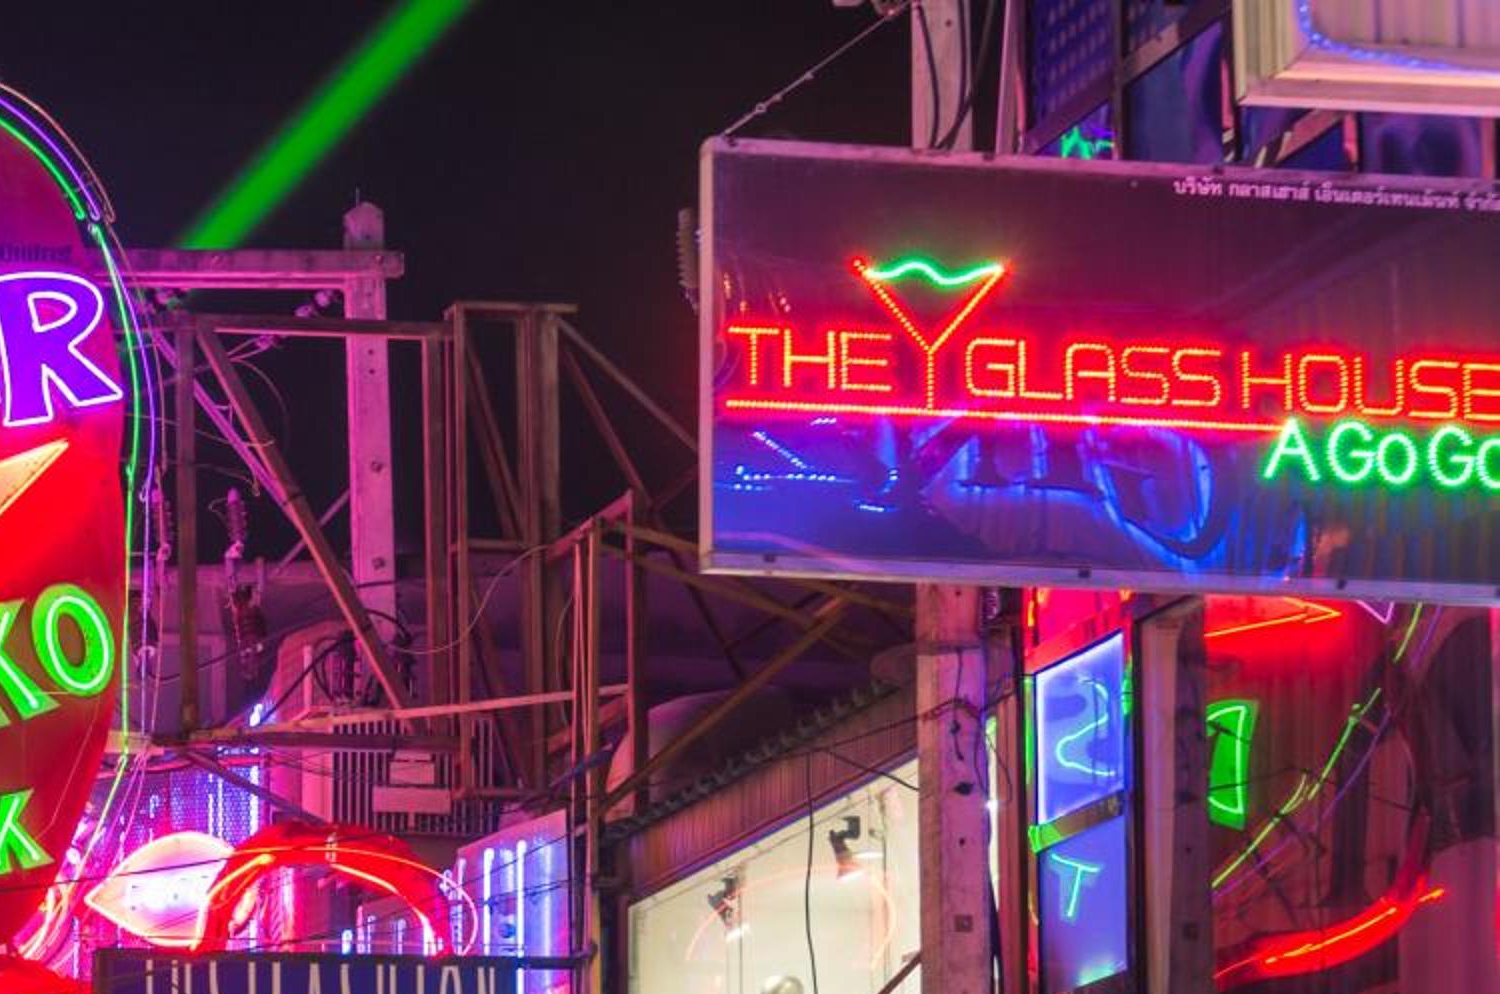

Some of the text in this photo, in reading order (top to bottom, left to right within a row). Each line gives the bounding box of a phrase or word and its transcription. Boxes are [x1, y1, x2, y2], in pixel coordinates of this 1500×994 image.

[965, 337, 1222, 408] GLASS
[1241, 350, 1500, 422] HOUSE
[1264, 418, 1321, 482] A
